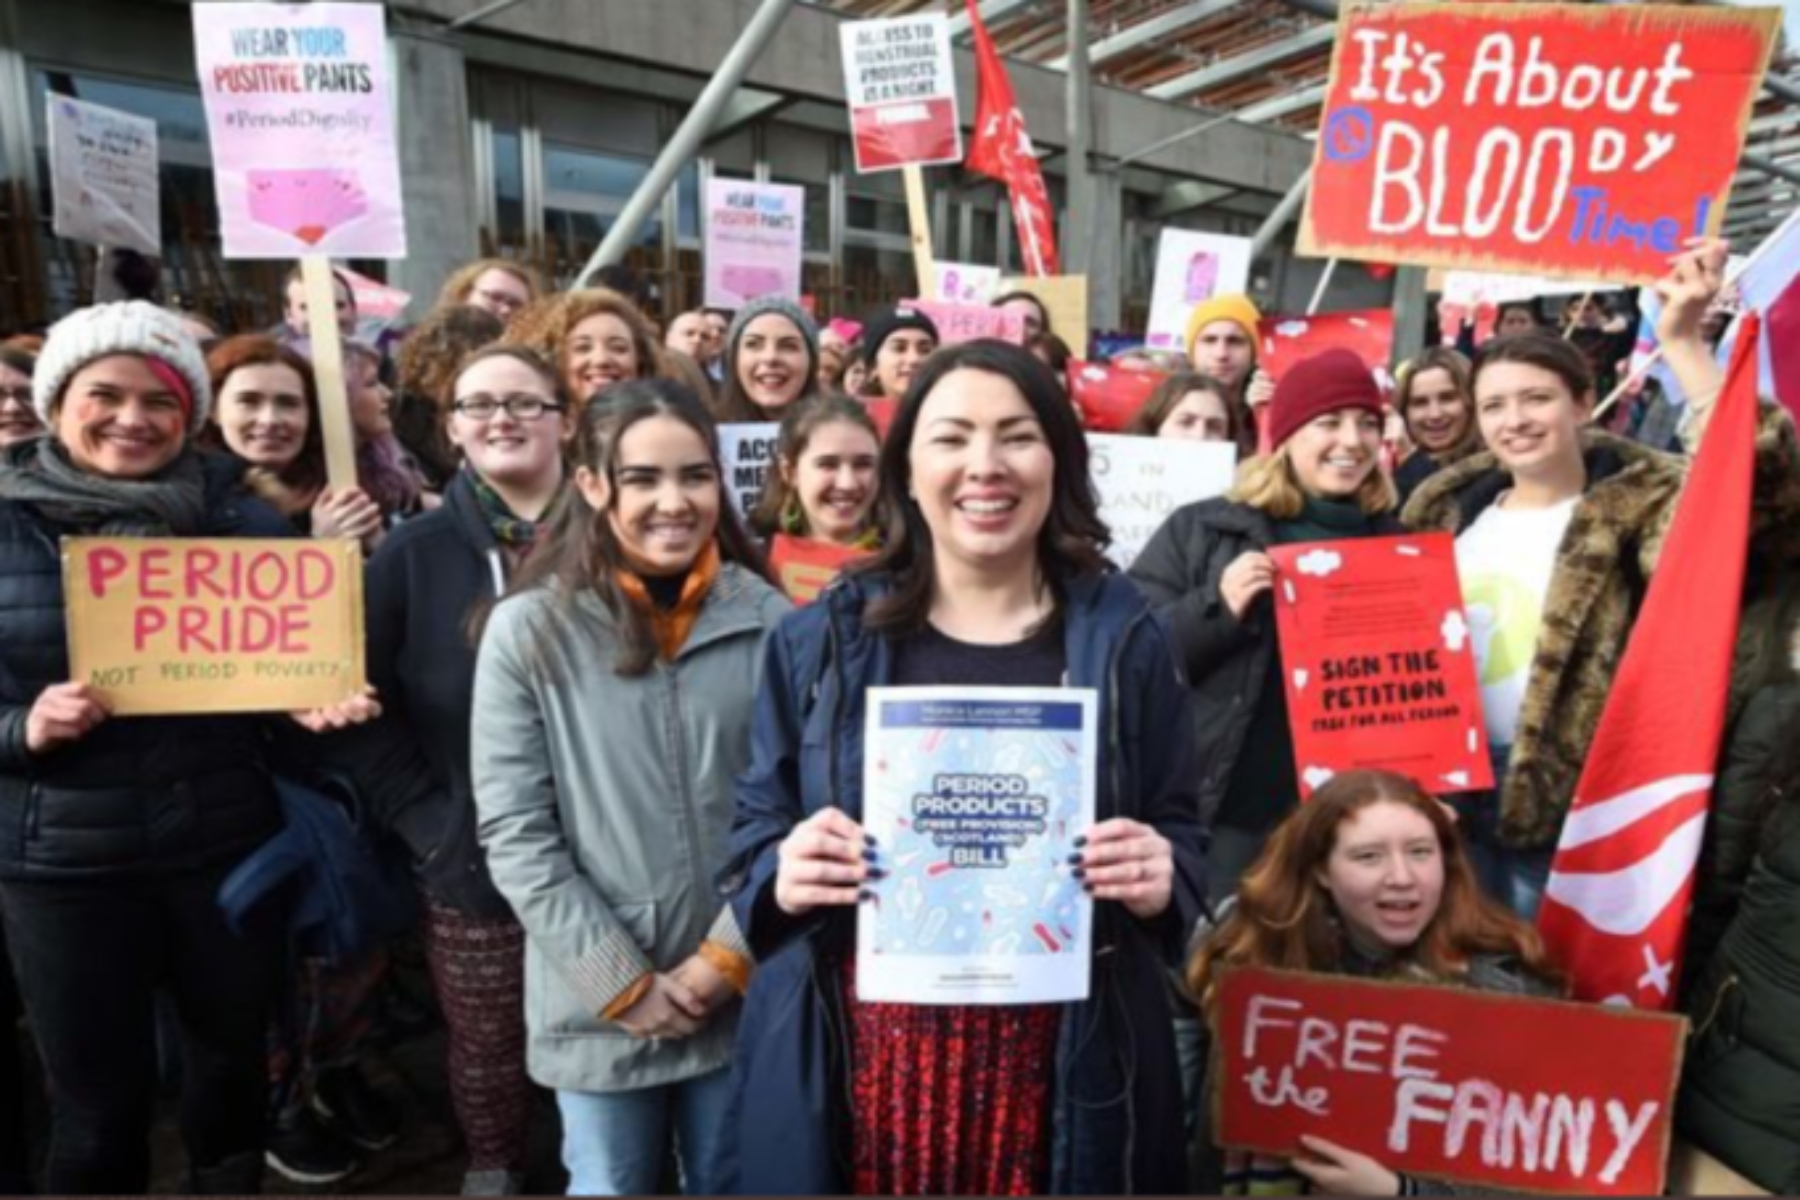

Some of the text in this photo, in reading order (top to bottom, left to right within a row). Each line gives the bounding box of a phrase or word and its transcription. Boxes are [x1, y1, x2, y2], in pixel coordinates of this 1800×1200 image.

[231, 27, 347, 56] WEAR YOUR
[214, 62, 373, 93] POSITIVE PANTS
[1350, 29, 1693, 115] It's About
[738, 438, 778, 461] ACC
[86, 546, 336, 601] PERIOD
[133, 604, 310, 653] PRIDE
[90, 666, 139, 687] NOT
[160, 662, 238, 679] PERIOD
[1320, 650, 1440, 682] SIGN THE
[1323, 678, 1446, 712] PETITION
[936, 775, 1026, 795] PERIOD
[915, 796, 1046, 816] PRODUCTS
[953, 846, 1006, 867] BILL
[1242, 994, 1449, 1080] FREE
[1242, 1064, 1330, 1117] the
[1387, 1076, 1659, 1185] FANNY
